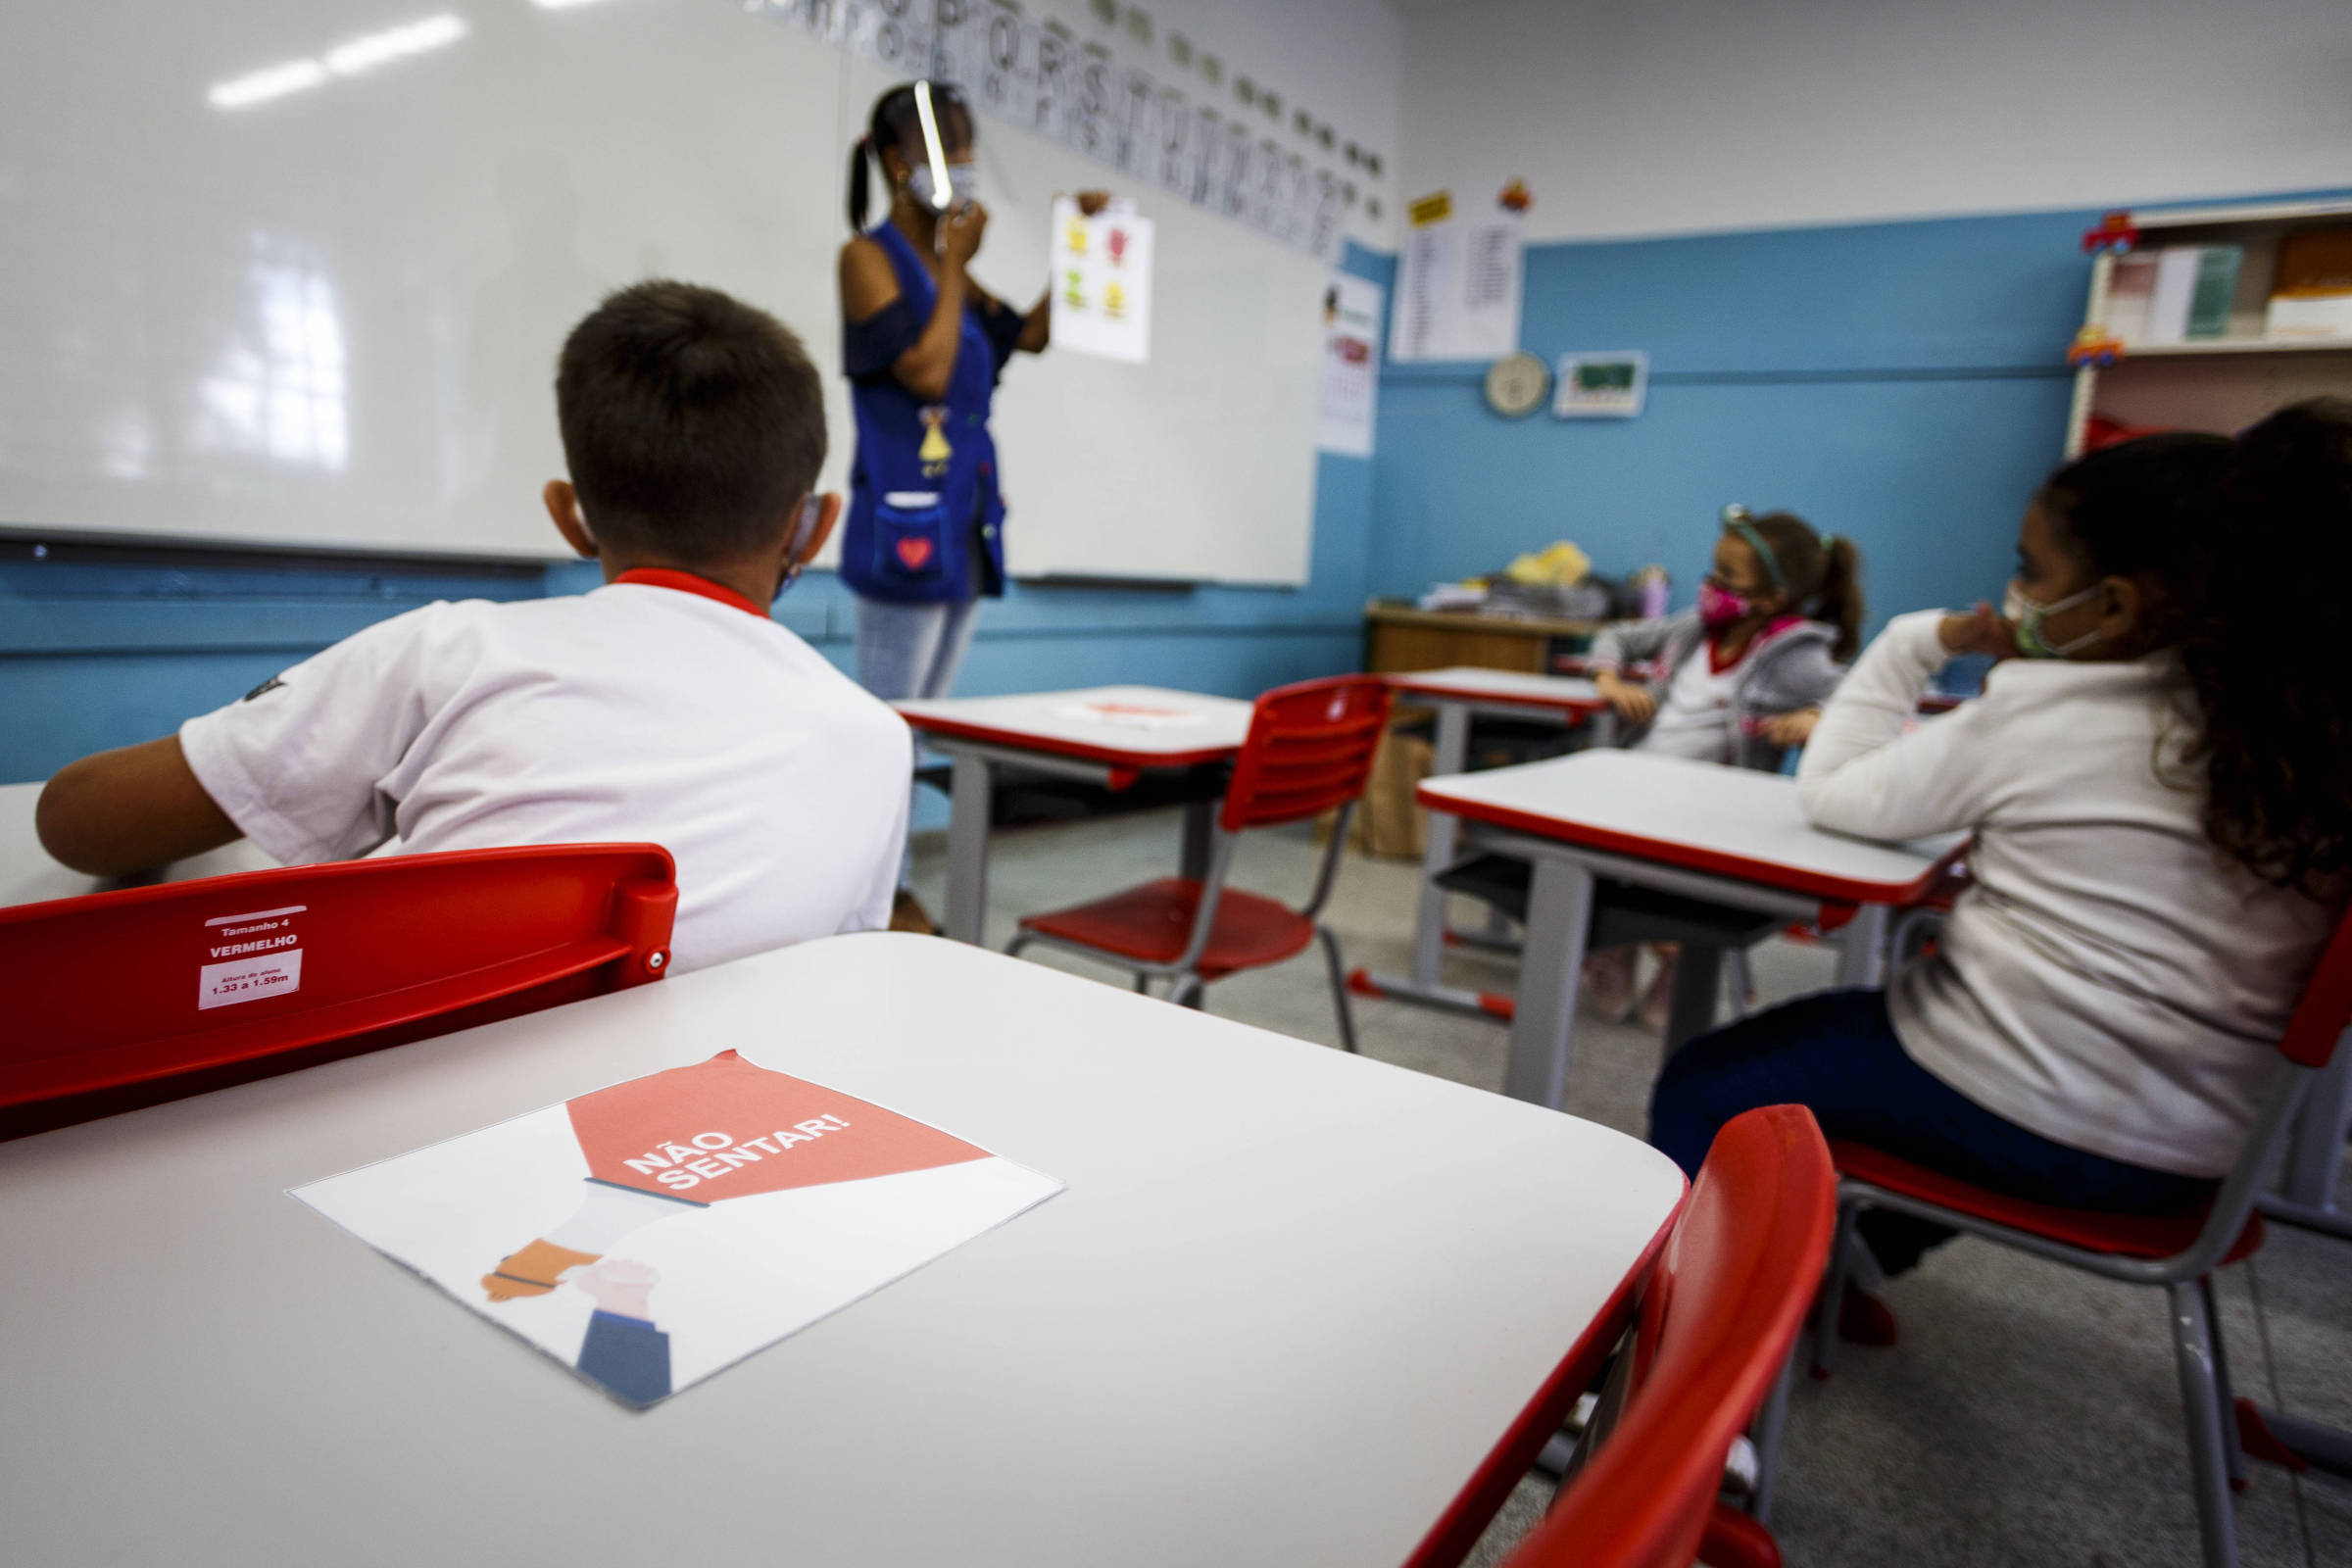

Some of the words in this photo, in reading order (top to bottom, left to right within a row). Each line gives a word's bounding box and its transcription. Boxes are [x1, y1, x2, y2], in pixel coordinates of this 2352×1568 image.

[221, 922, 278, 936] Tamanho
[210, 934, 298, 958] VERMELHO
[213, 983, 237, 995] 1.33
[253, 974, 289, 987] 1.59m
[622, 1131, 734, 1176] NÃO
[656, 1112, 852, 1191] SENTAR!
